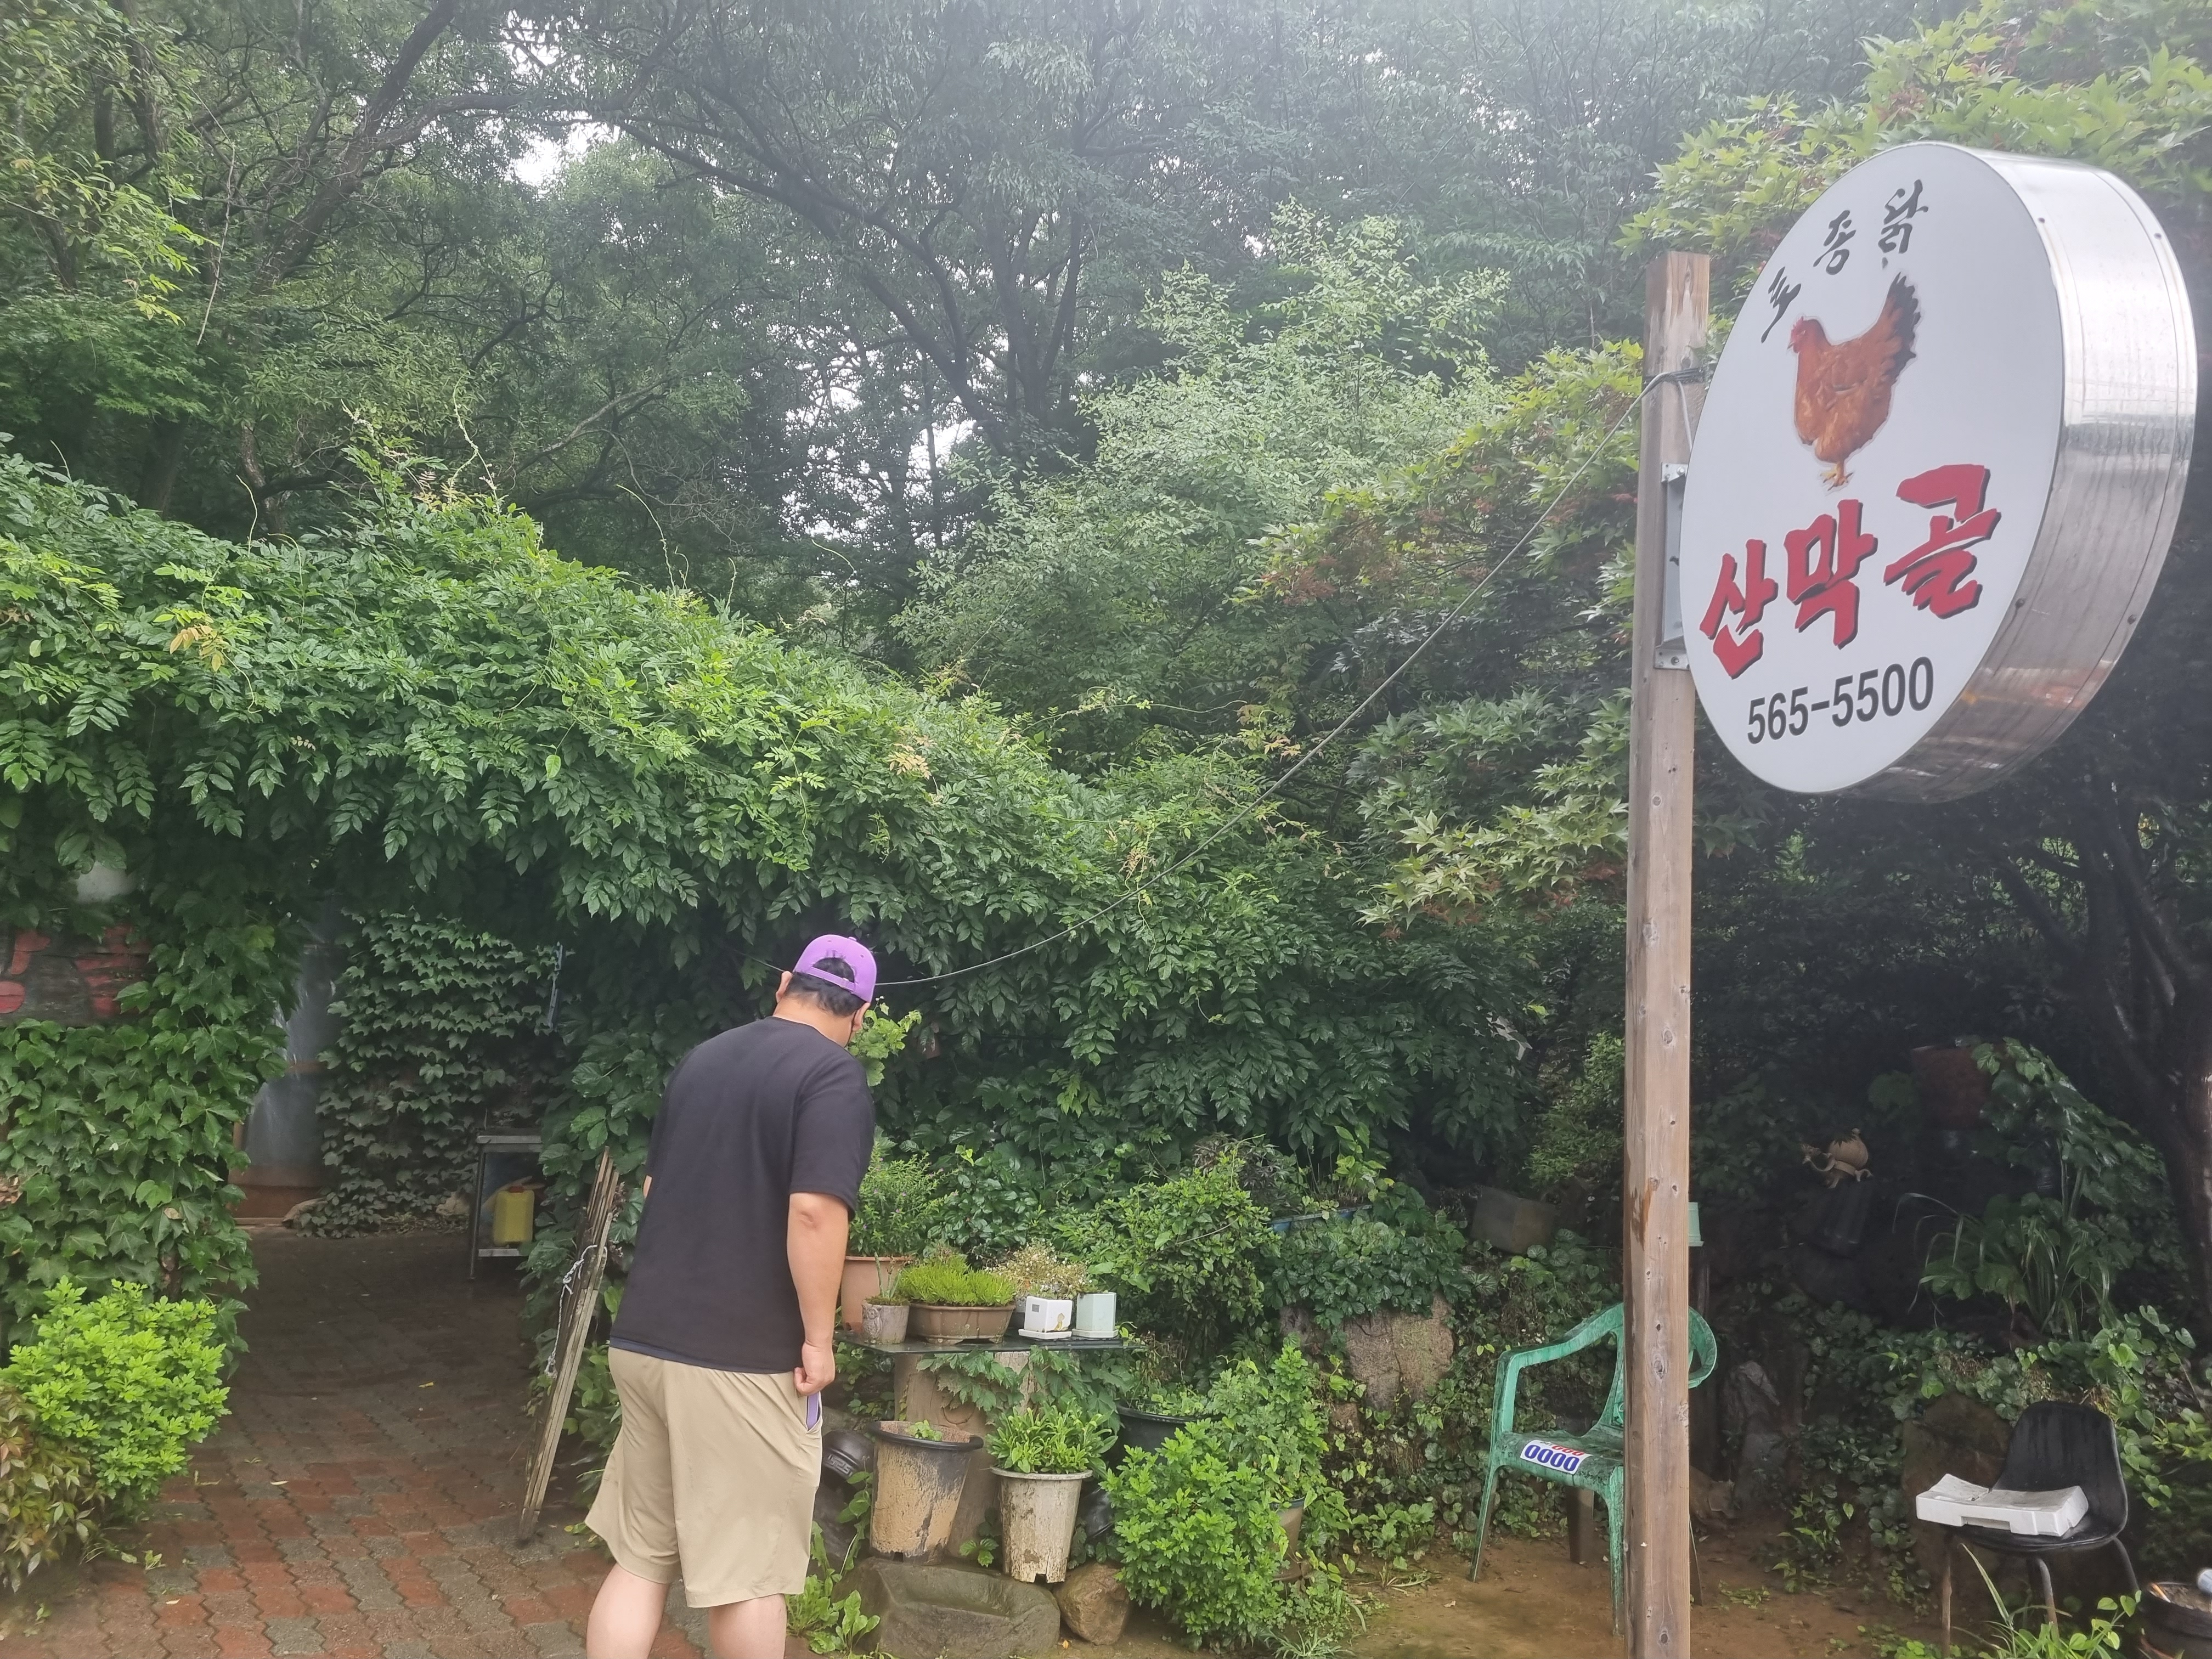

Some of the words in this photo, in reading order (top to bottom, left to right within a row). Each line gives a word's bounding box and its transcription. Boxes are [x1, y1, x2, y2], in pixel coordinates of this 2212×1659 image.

[1761, 179, 1929, 343] 토종닭
[1699, 463, 2002, 680] 산막골
[1747, 656, 1934, 744] 565-5500
[1525, 1444, 1580, 1471] 0000
